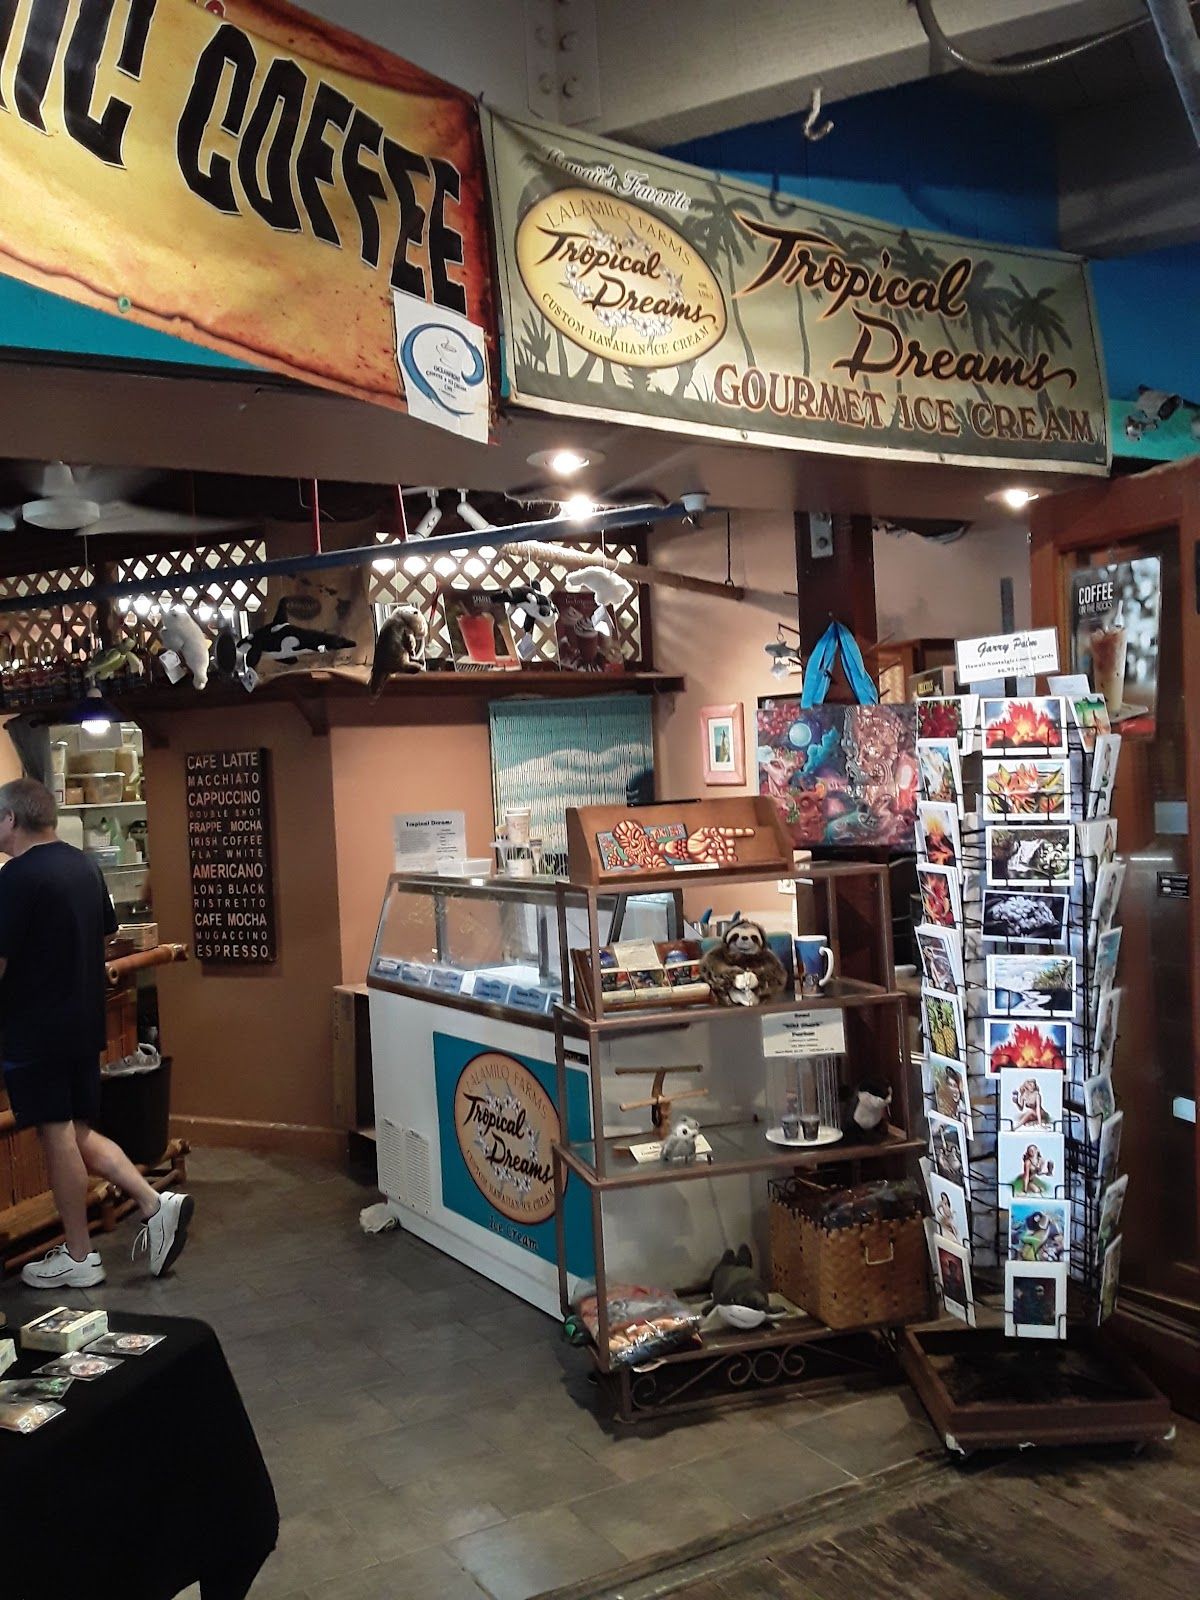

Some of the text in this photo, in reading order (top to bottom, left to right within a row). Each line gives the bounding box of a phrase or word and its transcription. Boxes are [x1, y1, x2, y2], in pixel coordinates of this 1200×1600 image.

[176, 23, 468, 316] COFFEE
[617, 169, 692, 212] Favorite
[546, 199, 631, 229] LALAMILO
[535, 224, 661, 278] Tropical
[733, 211, 973, 321] Tropical
[582, 271, 716, 324] Dreams
[542, 292, 709, 356] CUSTOM HAWAIIAN ICE CREAM
[833, 308, 1077, 390] Dreams
[713, 363, 1096, 445] GOURMET ICE CREAM
[1078, 582, 1114, 605] COFFEE
[977, 641, 1010, 657] Garry
[187, 752, 259, 769] CAFE LATTE
[187, 772, 260, 787] MACCHIATO
[188, 789, 261, 807] CAPPUCCINO
[189, 820, 263, 833] FRAPPE MOCHA
[190, 835, 263, 847] IRISH COFFEE
[191, 849, 263, 859] FLAT WHITE
[193, 863, 264, 879] AMERICANO
[193, 883, 265, 895] LONG BLACK
[193, 898, 266, 908] RISTRETTO
[195, 912, 267, 926] CAFE MOCHA
[197, 944, 269, 958] ESPRESSO
[463, 1092, 527, 1139] Tropical
[486, 1132, 555, 1182] Dreams
